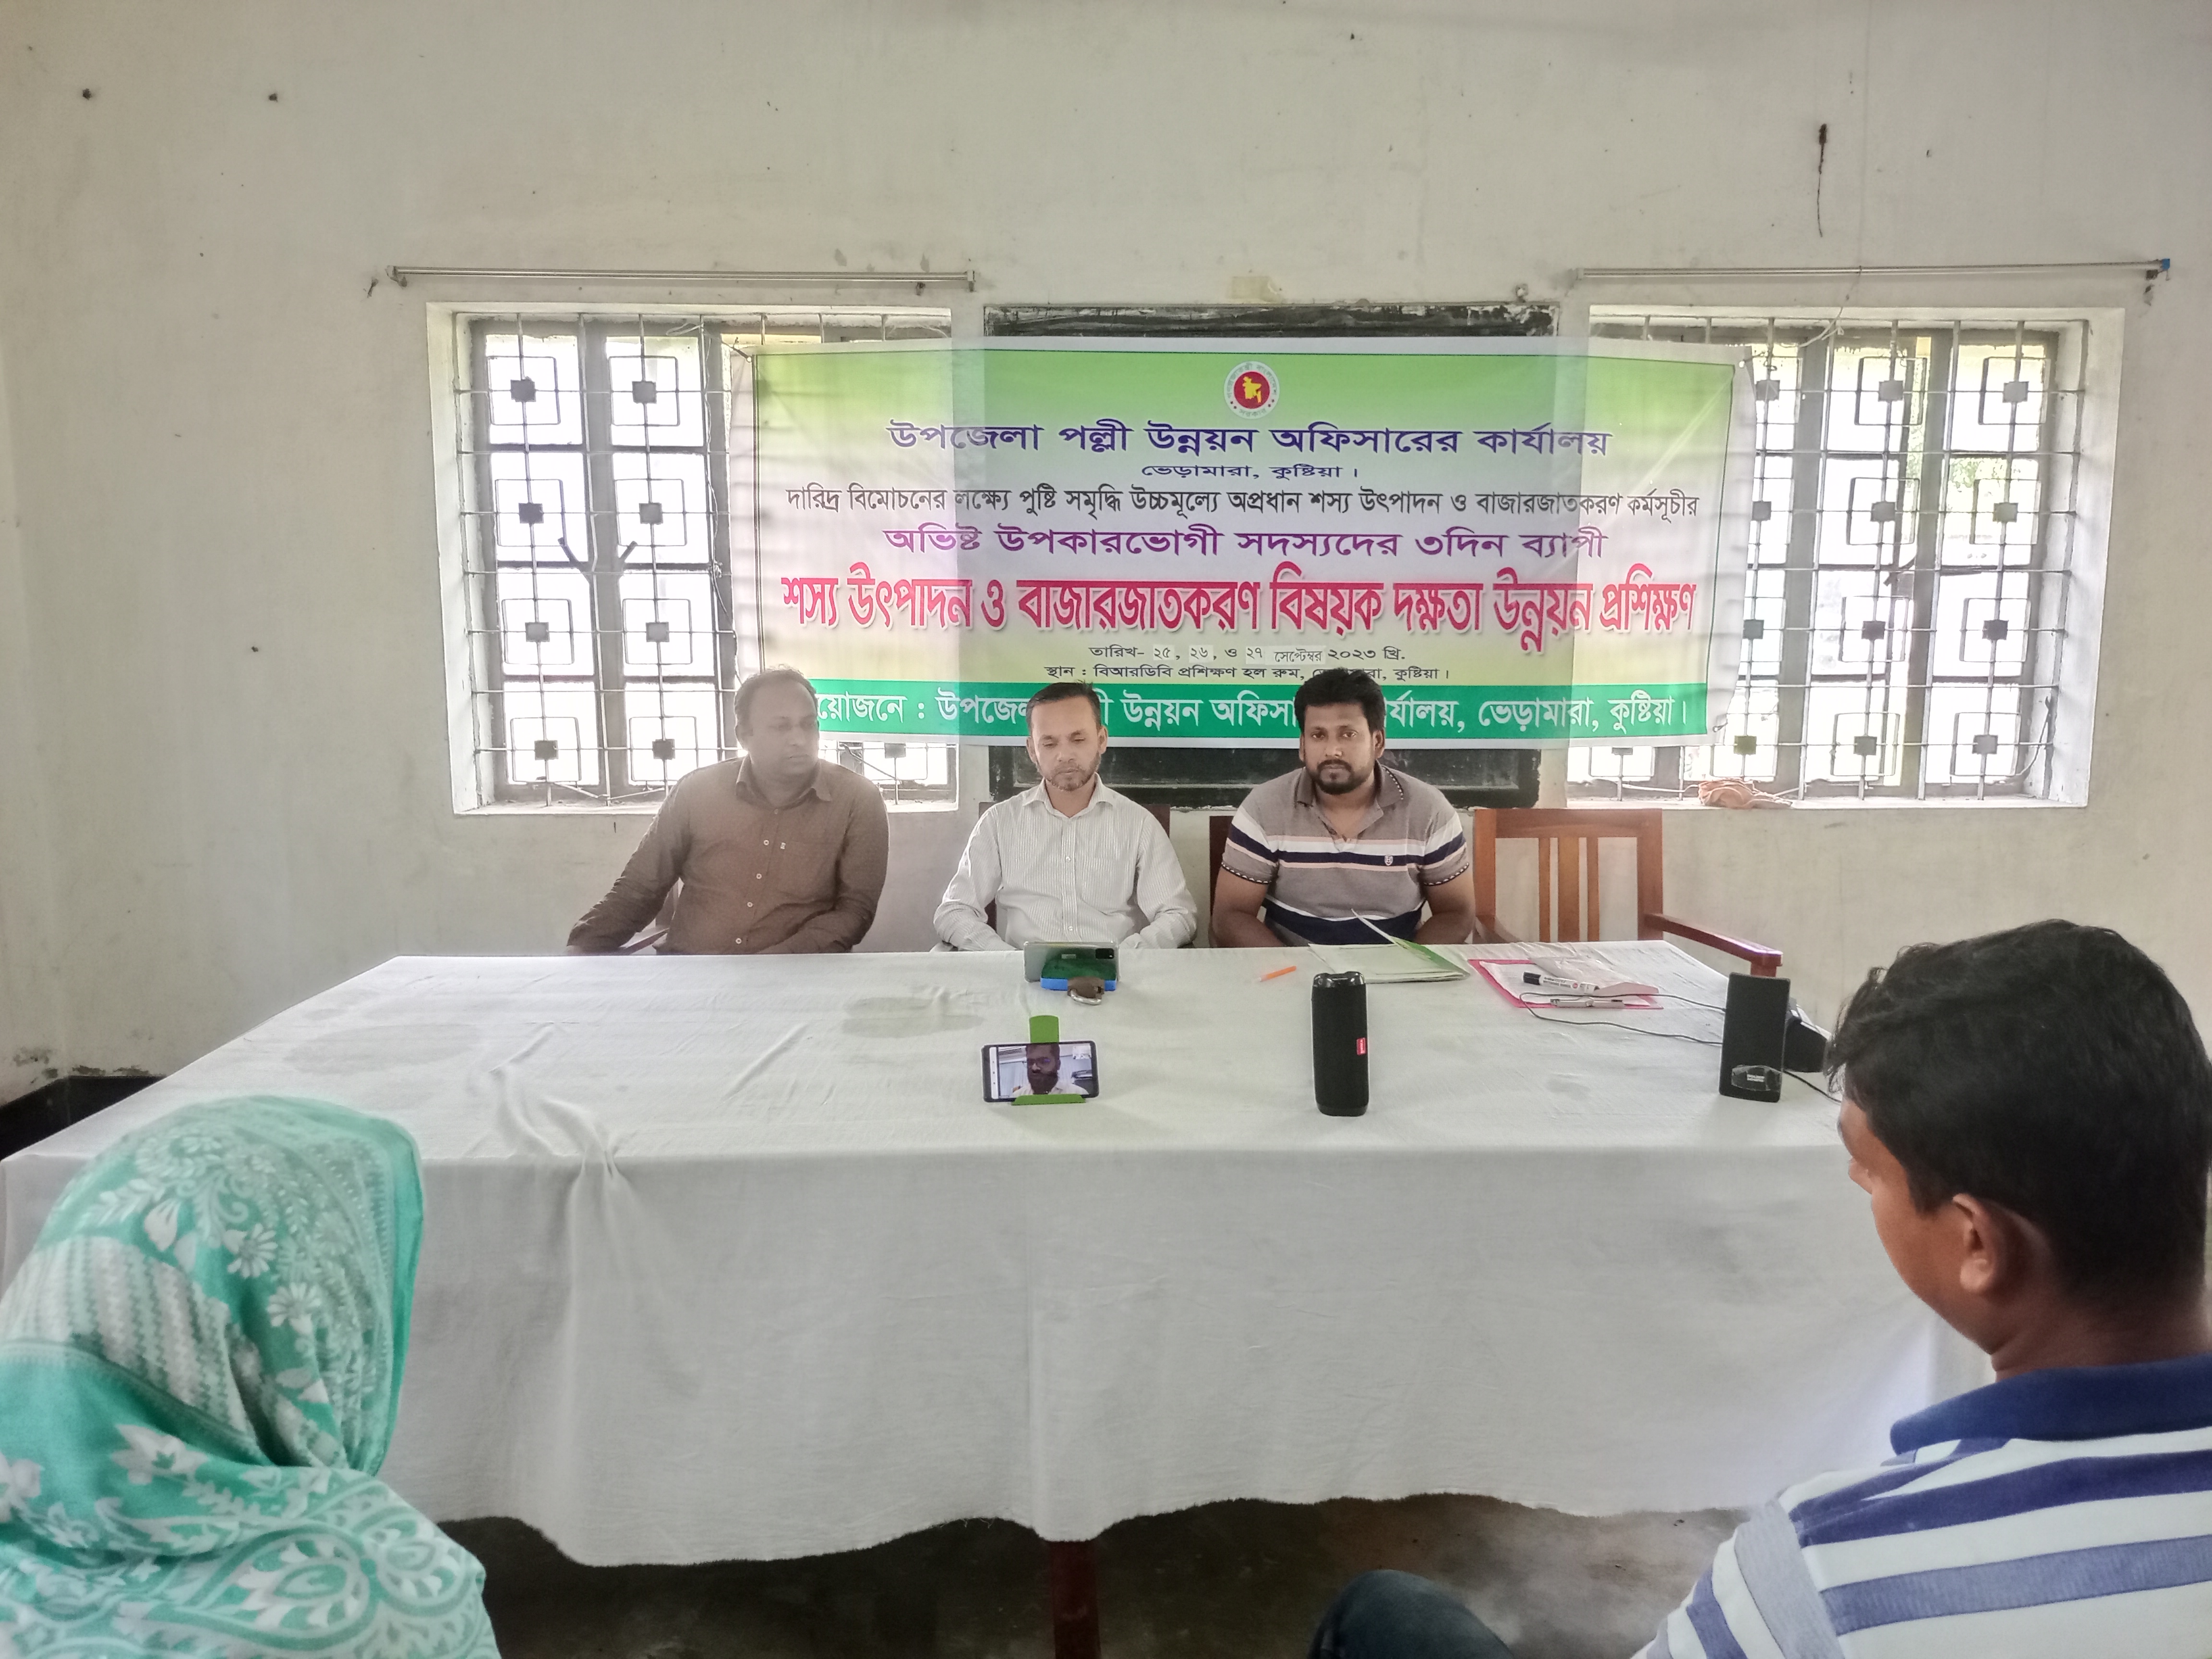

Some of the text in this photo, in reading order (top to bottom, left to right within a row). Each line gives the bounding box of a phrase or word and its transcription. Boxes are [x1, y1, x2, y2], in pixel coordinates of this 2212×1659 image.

[886, 419, 1612, 456] উপজেলা পল্লী উন্নয়ন অফিসারের কার্যালয়
[1142, 464, 1260, 480] ভেড়ামারা,
[1269, 464, 1345, 481] কুষ্টিয়া
[786, 482, 1699, 522] দারিদ্র বিমোচনের লক্ষ্যে পুষ্টি সমৃদ্ধি উচ্চমূল্যে অপ্রধান শস্য উৎপাদন ও বাজারজাতকরণ কর্মসূচীর
[882, 522, 1609, 557] অভিষ্ট উপকারভোগী সদস্যদের ৩দিন ব্যাপী
[781, 562, 1697, 652] শস্য উৎপাদন ও বাজারজাতকরণ বিষয়ক দক্ষতা উন্নয়ন প্রশিক্ষণ
[1088, 645, 1144, 658] তারিখ-
[1225, 649, 1237, 657] ও
[1247, 648, 1262, 659] ২৭
[1328, 649, 1376, 660] ২০২৩
[1045, 665, 1075, 678] স্থান
[1093, 664, 1173, 678] বিআরডিবি
[1178, 664, 1237, 678] প্রশিক্ষণ
[1242, 669, 1267, 679] হল
[1272, 668, 1304, 680] রুম,
[1393, 666, 1440, 681] কুষ্টিয়া
[816, 691, 907, 723] য়োজনে
[934, 687, 1030, 723] উপজে
[1121, 688, 1203, 731] উন্নয়ন
[1210, 690, 1296, 727] অফিসা
[1384, 690, 1465, 733] ার্যালয়,
[1479, 697, 1599, 732] ভেড়ামারা,
[1608, 689, 1675, 734] কুষ্টিয়া
